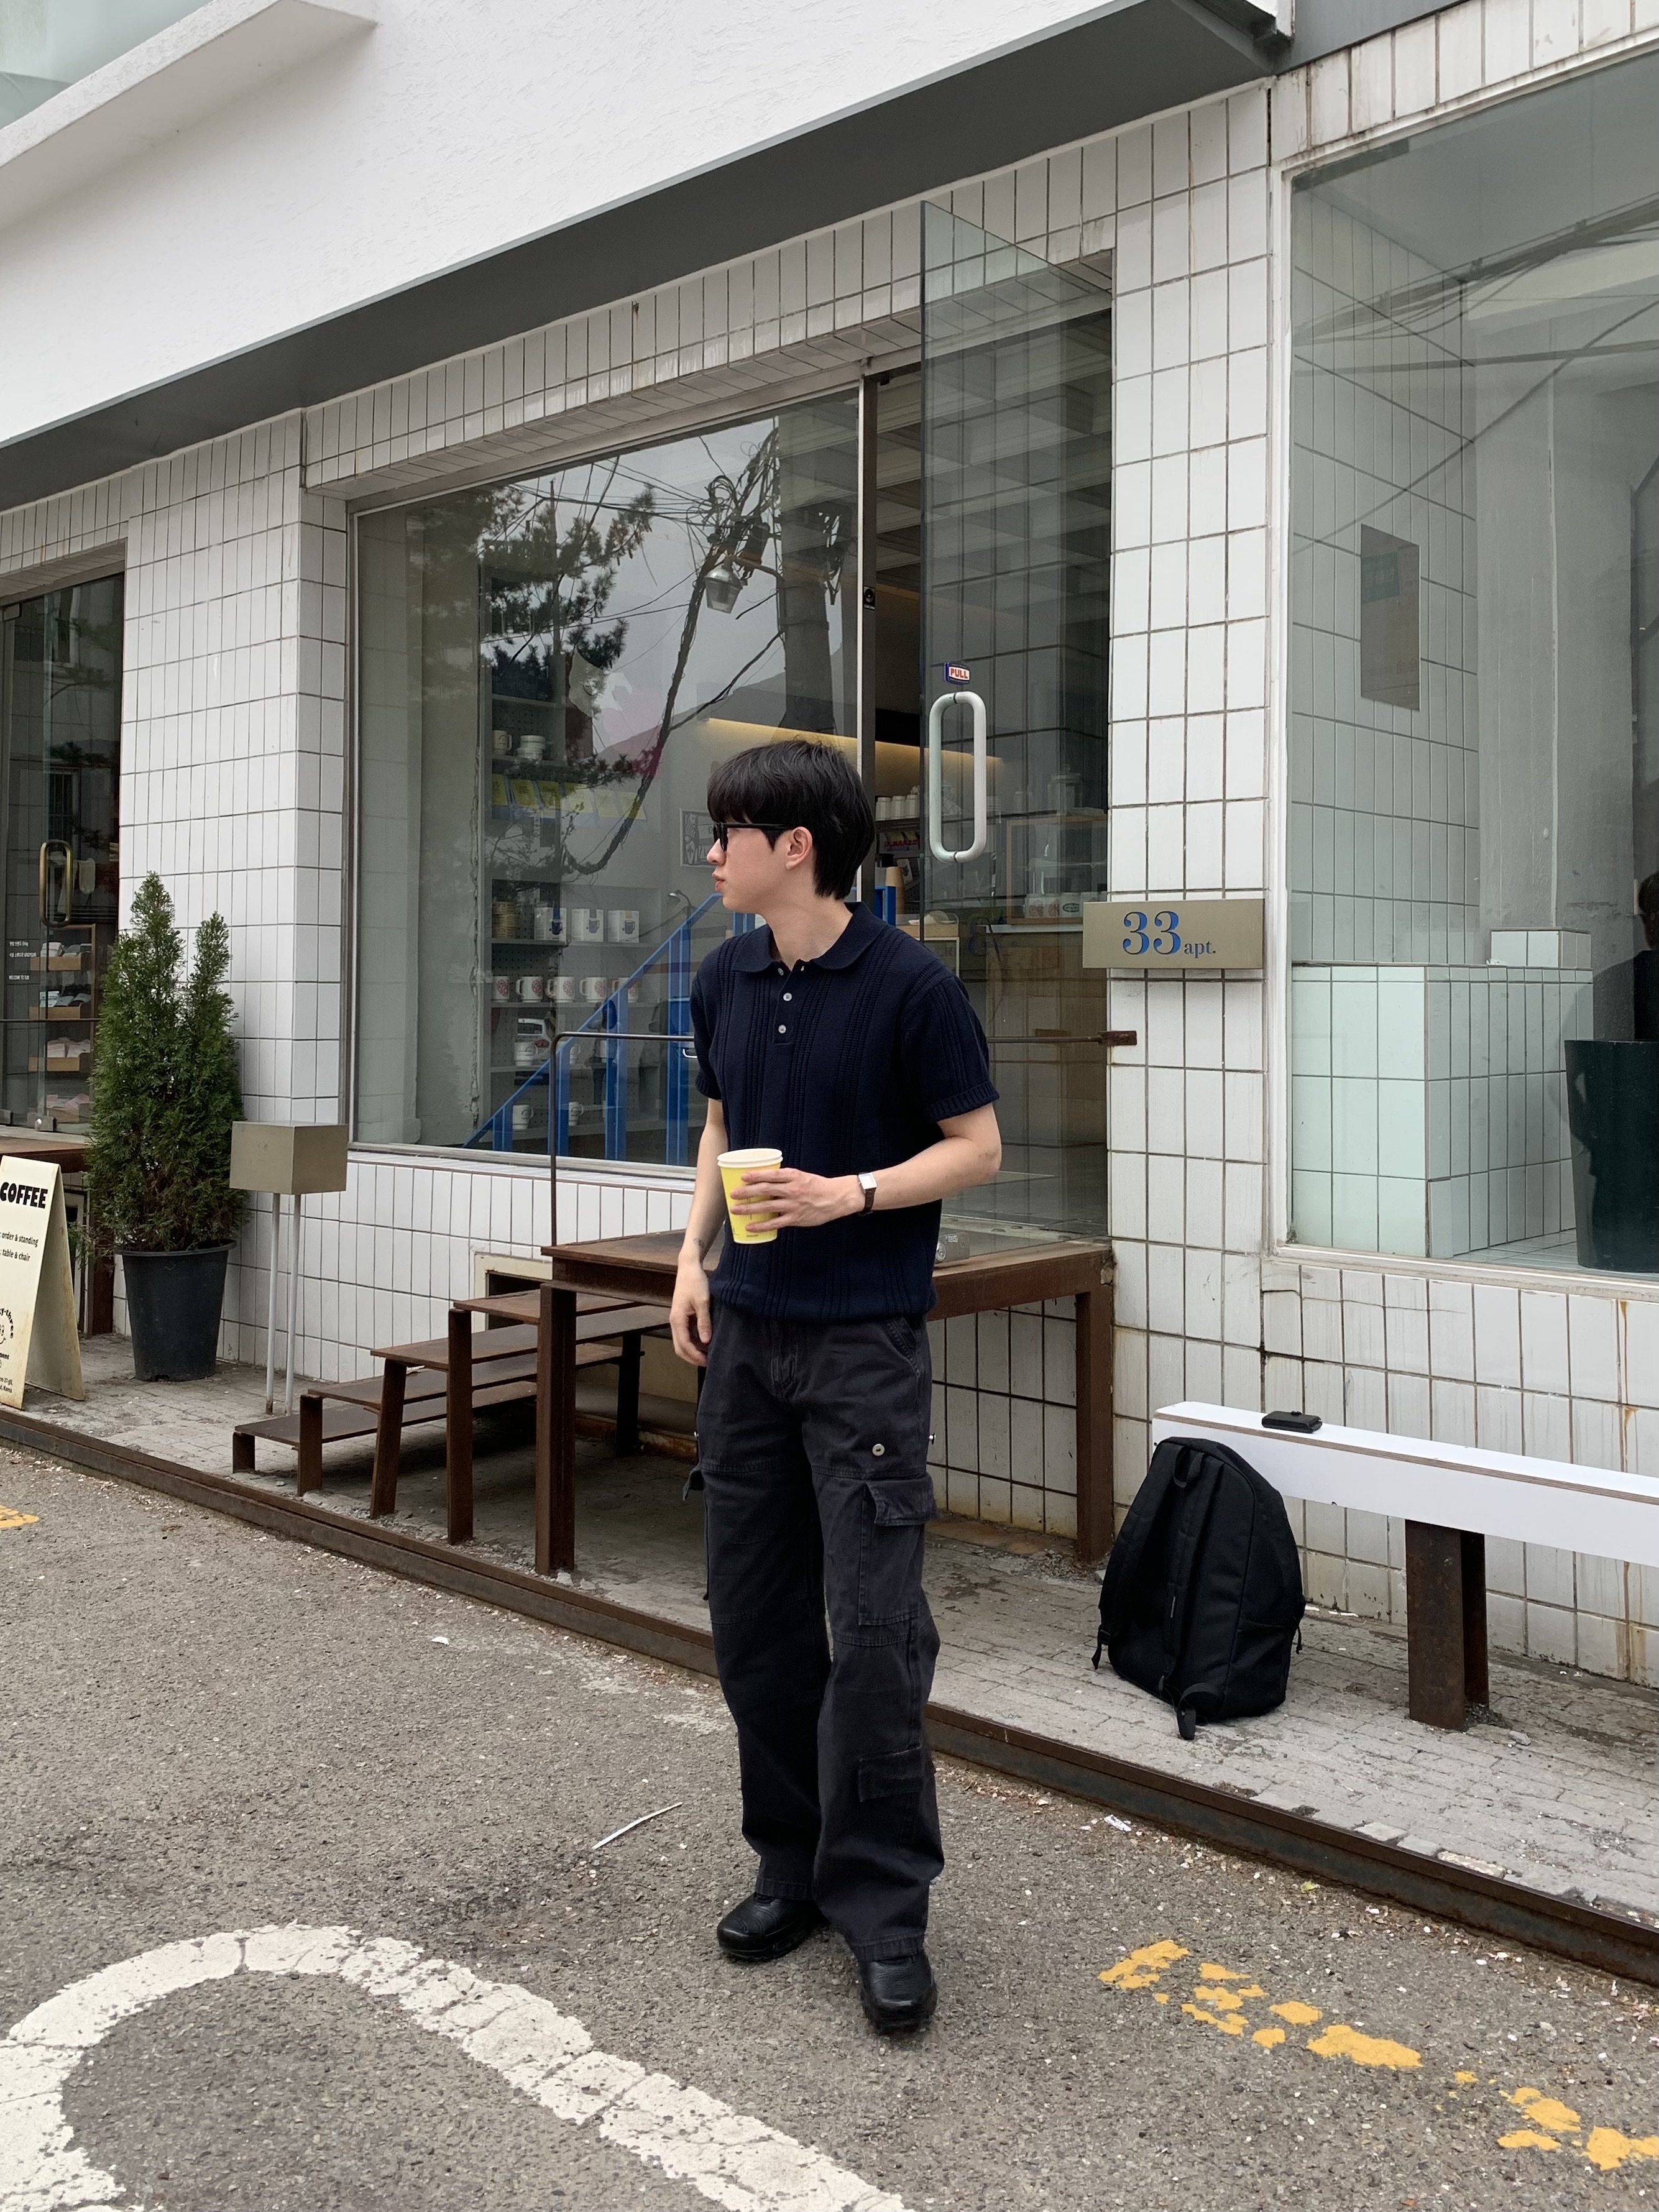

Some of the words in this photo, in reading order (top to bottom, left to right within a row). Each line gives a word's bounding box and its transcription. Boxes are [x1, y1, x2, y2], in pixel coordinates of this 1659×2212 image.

[950, 668, 968, 679] PULL
[1122, 911, 1181, 955] 33
[1183, 940, 1216, 958] apt.
[0, 1182, 48, 1209] COFFEE
[2, 1232, 14, 1241] order
[14, 1234, 18, 1242] &
[19, 1236, 39, 1247] standing
[2, 1249, 14, 1259] table
[19, 1252, 30, 1262] chair
